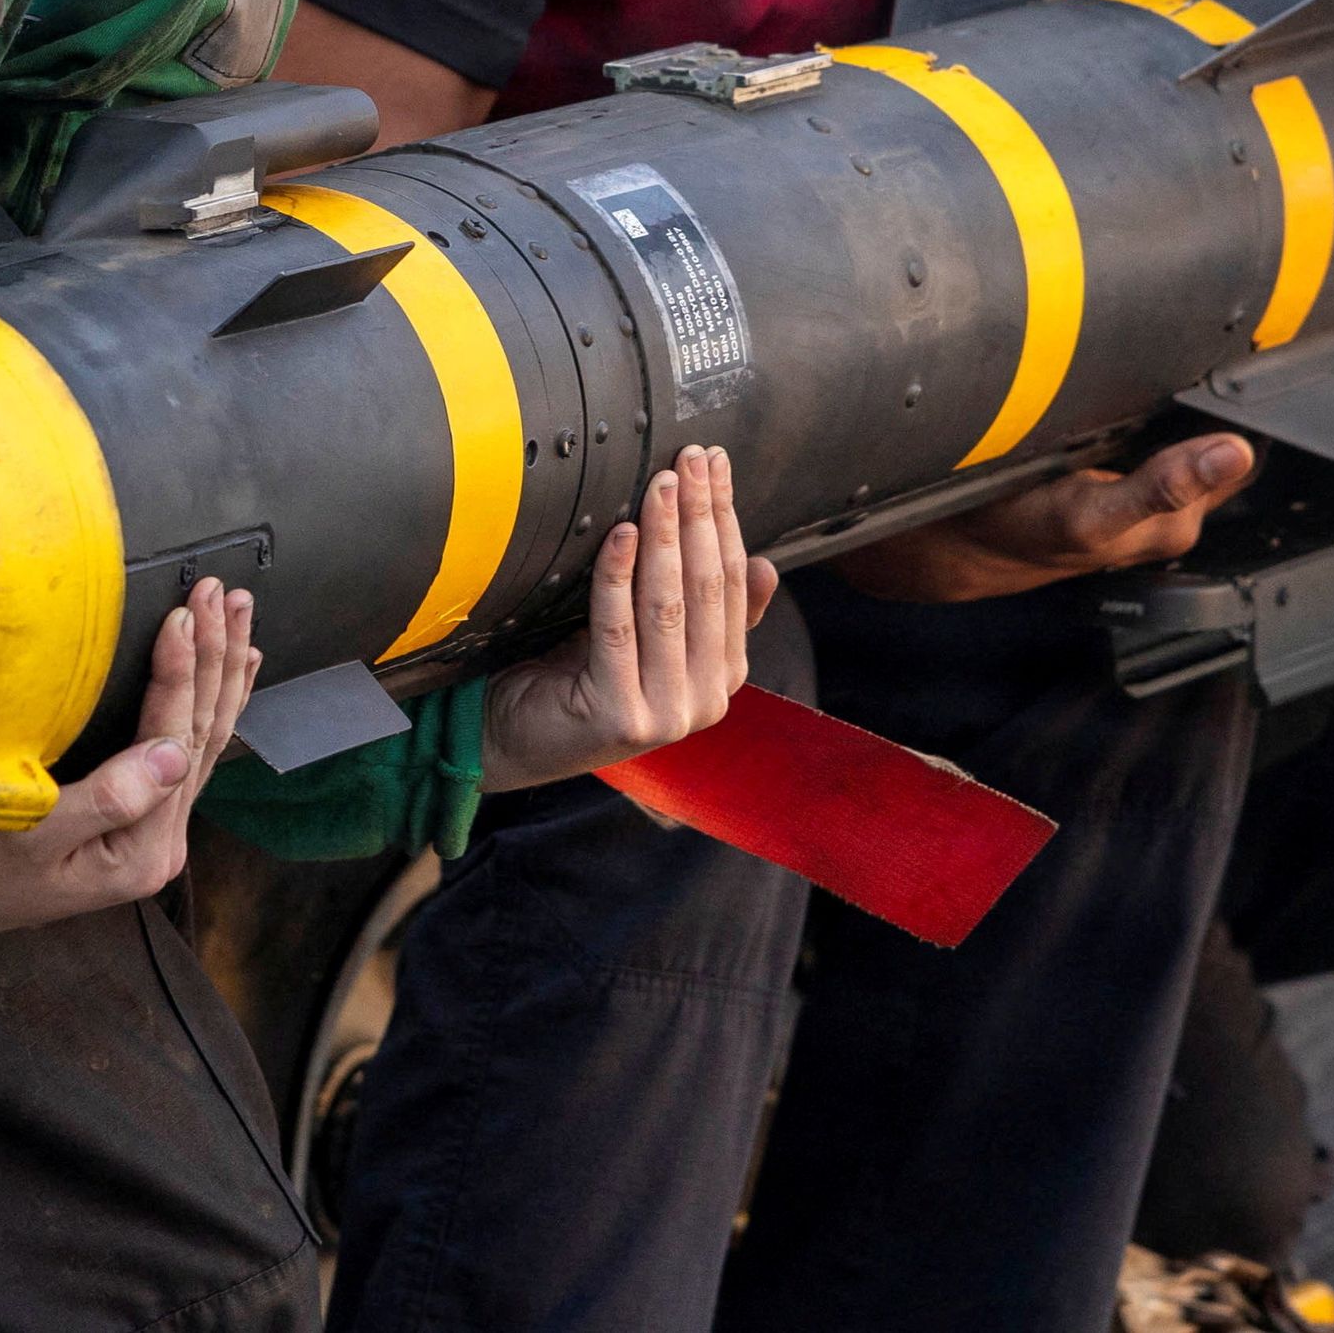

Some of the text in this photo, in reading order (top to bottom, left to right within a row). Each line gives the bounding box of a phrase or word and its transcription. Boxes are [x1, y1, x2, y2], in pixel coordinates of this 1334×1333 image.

[699, 331, 711, 369] CAGE
[710, 340, 720, 366] LOT
[719, 334, 730, 364] NSN
[726, 317, 740, 360] DODIC
[681, 345, 693, 374] PNO
[691, 342, 702, 371] SER
